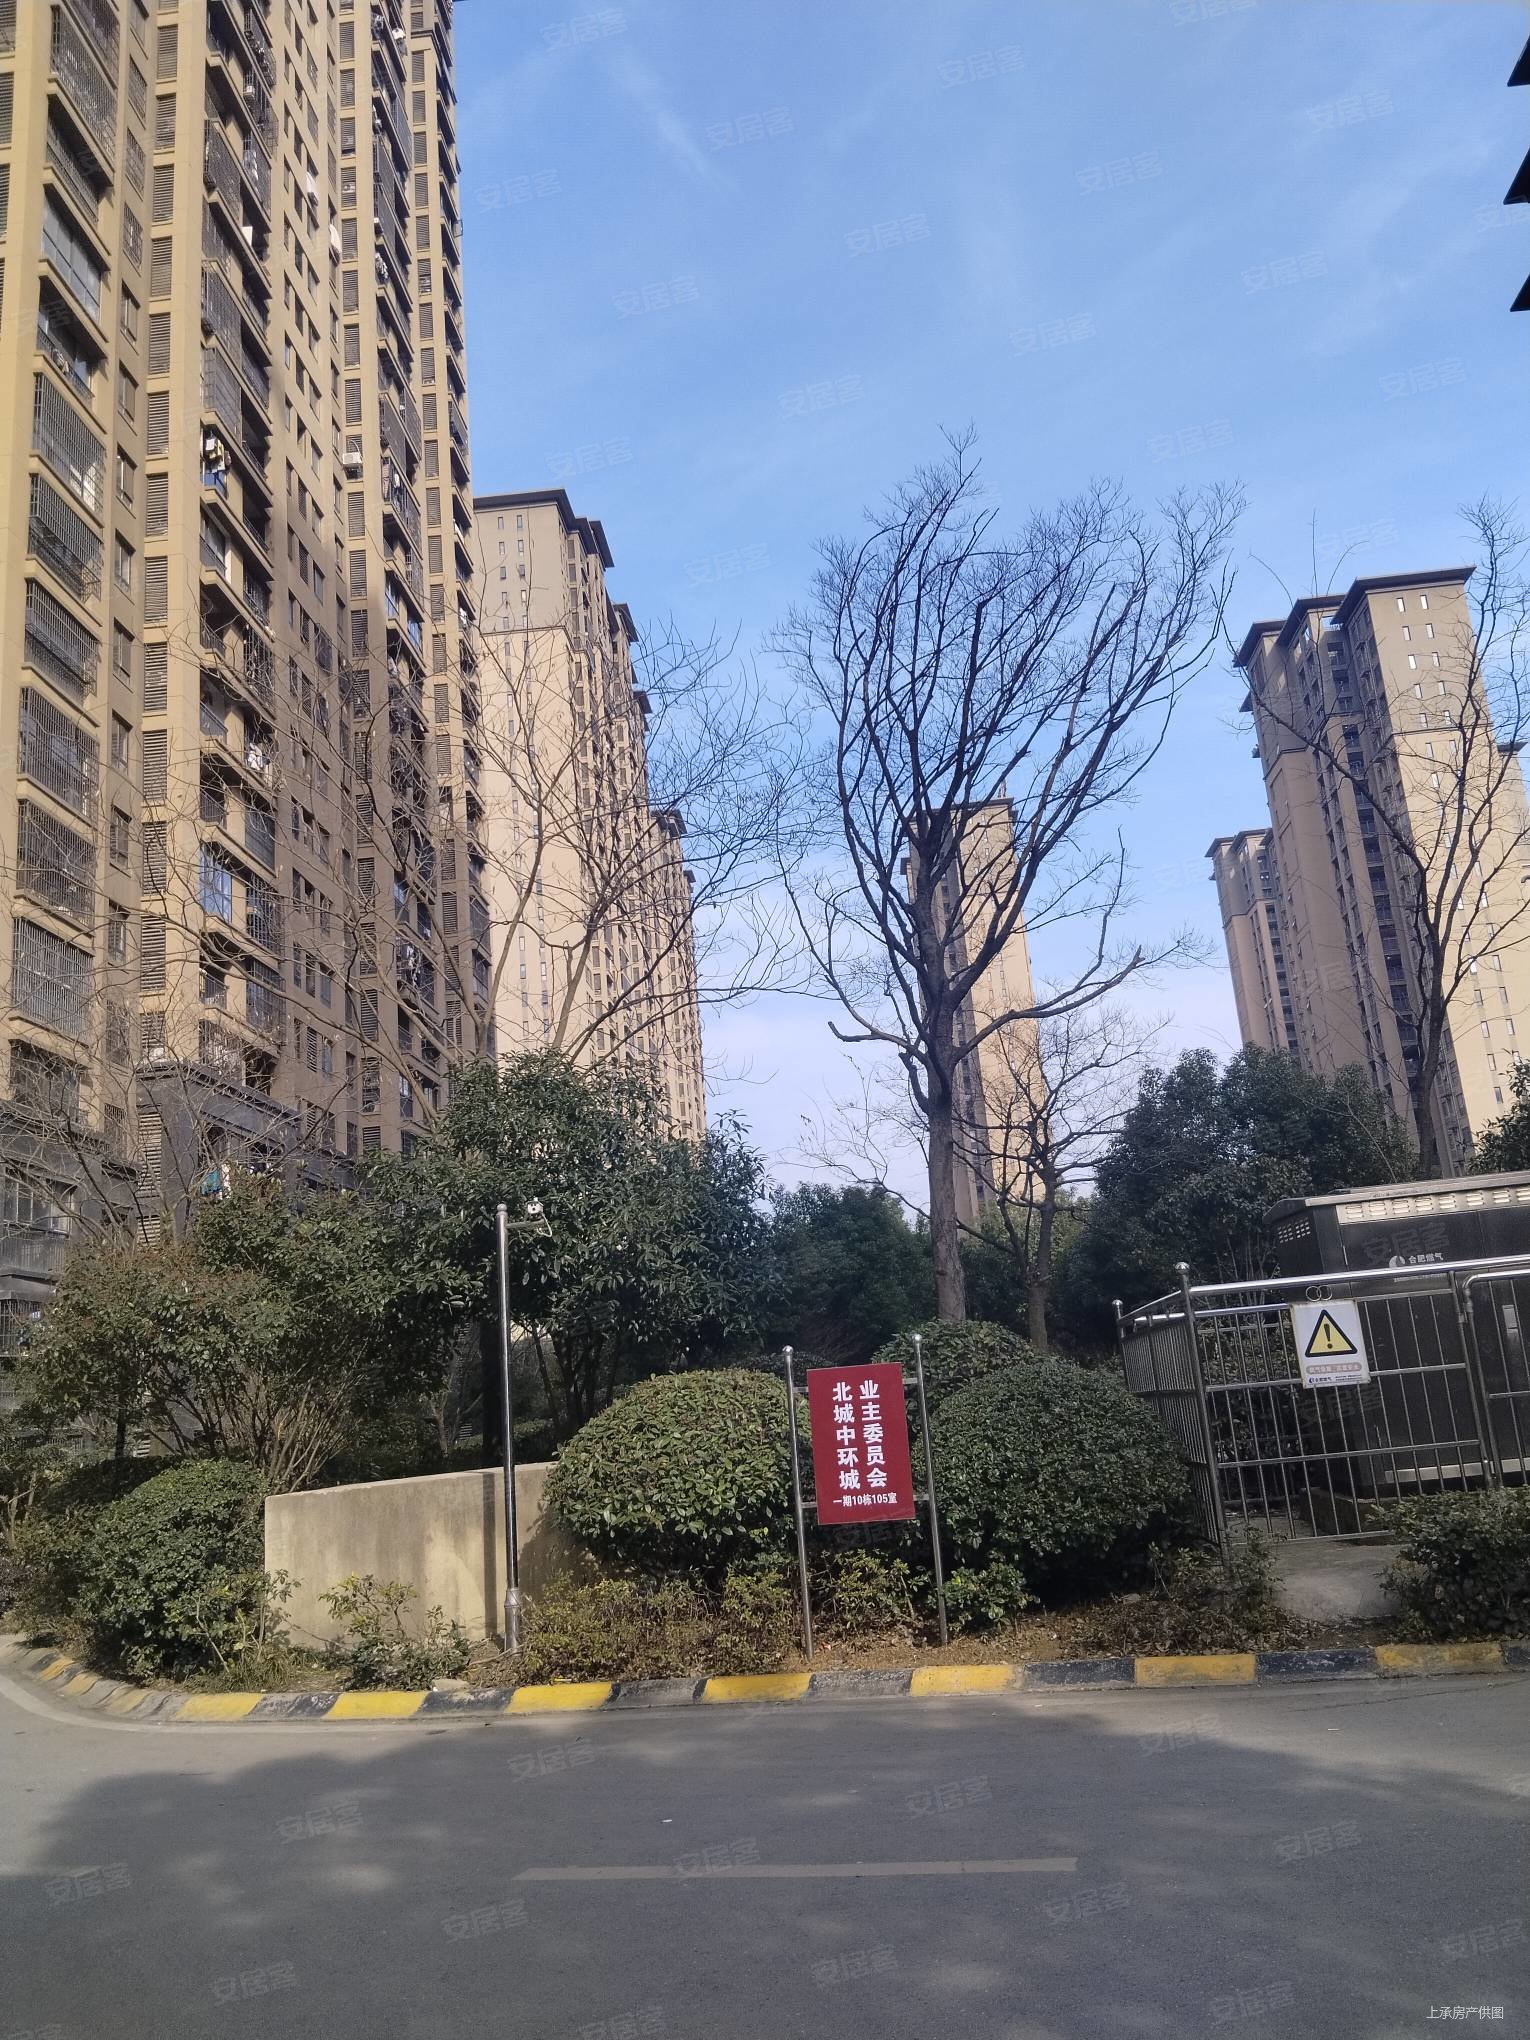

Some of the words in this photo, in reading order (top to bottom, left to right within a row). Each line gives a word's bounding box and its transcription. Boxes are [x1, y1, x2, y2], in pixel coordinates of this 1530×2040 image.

[832, 1382, 861, 1490] 北城中环城
[859, 1380, 887, 1488] 业主委员会
[833, 1492, 897, 1507] 一期10栋105室
